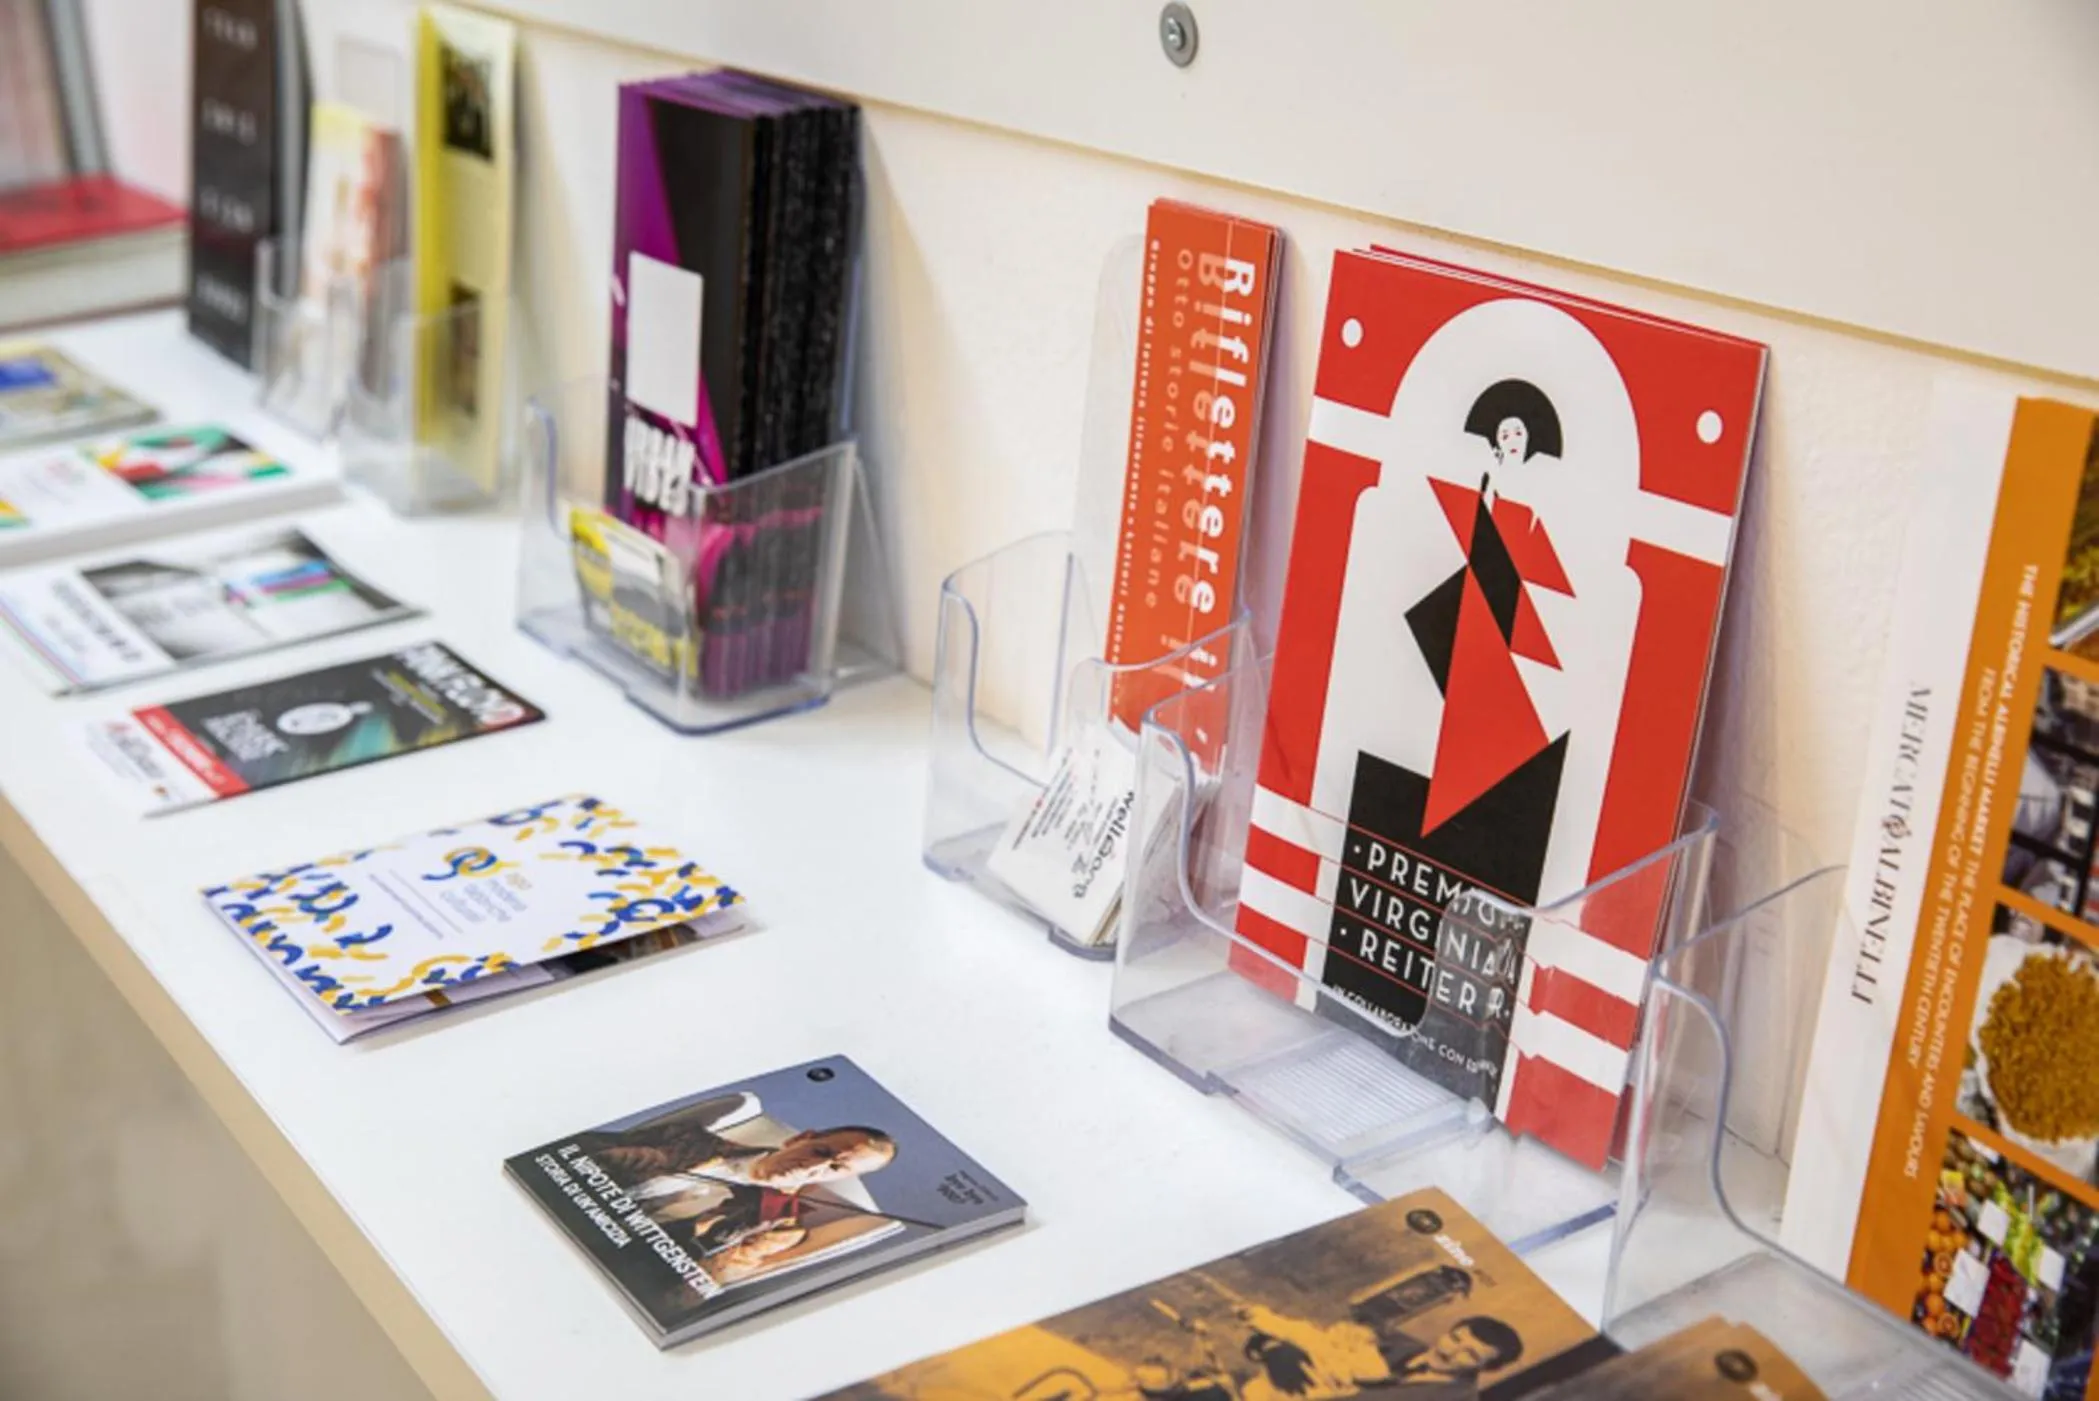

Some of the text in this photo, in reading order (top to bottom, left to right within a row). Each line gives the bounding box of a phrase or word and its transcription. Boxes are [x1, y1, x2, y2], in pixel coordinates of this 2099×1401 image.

[1144, 247, 1194, 608] Otto storie italiane
[1190, 257, 1256, 614] Riflettere
[1367, 841, 1496, 927] PREMIO
[1359, 928, 1478, 1015] REITER
[570, 1155, 625, 1201] NIPOTE
[609, 1195, 638, 1215] DI
[623, 1208, 724, 1300] WITTGENSTEIN
